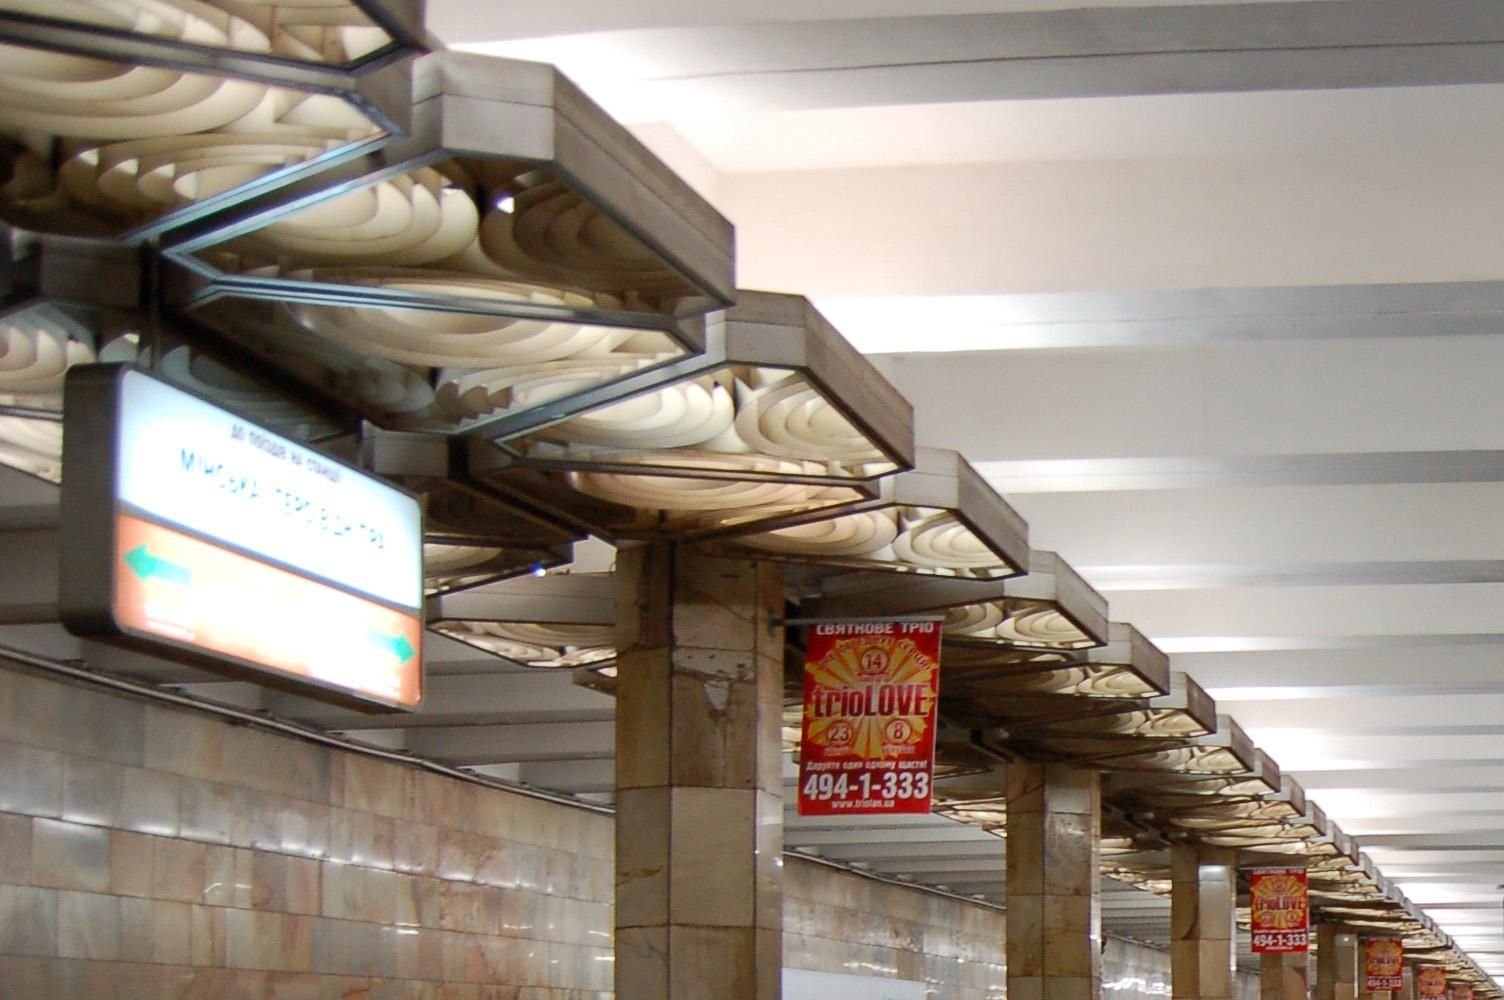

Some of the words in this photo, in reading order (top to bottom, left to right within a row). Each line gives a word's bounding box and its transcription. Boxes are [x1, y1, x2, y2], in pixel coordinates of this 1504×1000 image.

[816, 623, 894, 635] СВЯТКОВЕ
[866, 653, 881, 668] 14
[812, 684, 929, 718] trioLOVE
[830, 726, 849, 740] 23
[803, 772, 929, 800] 494-1-333
[1254, 934, 1307, 946] 494-1-333
